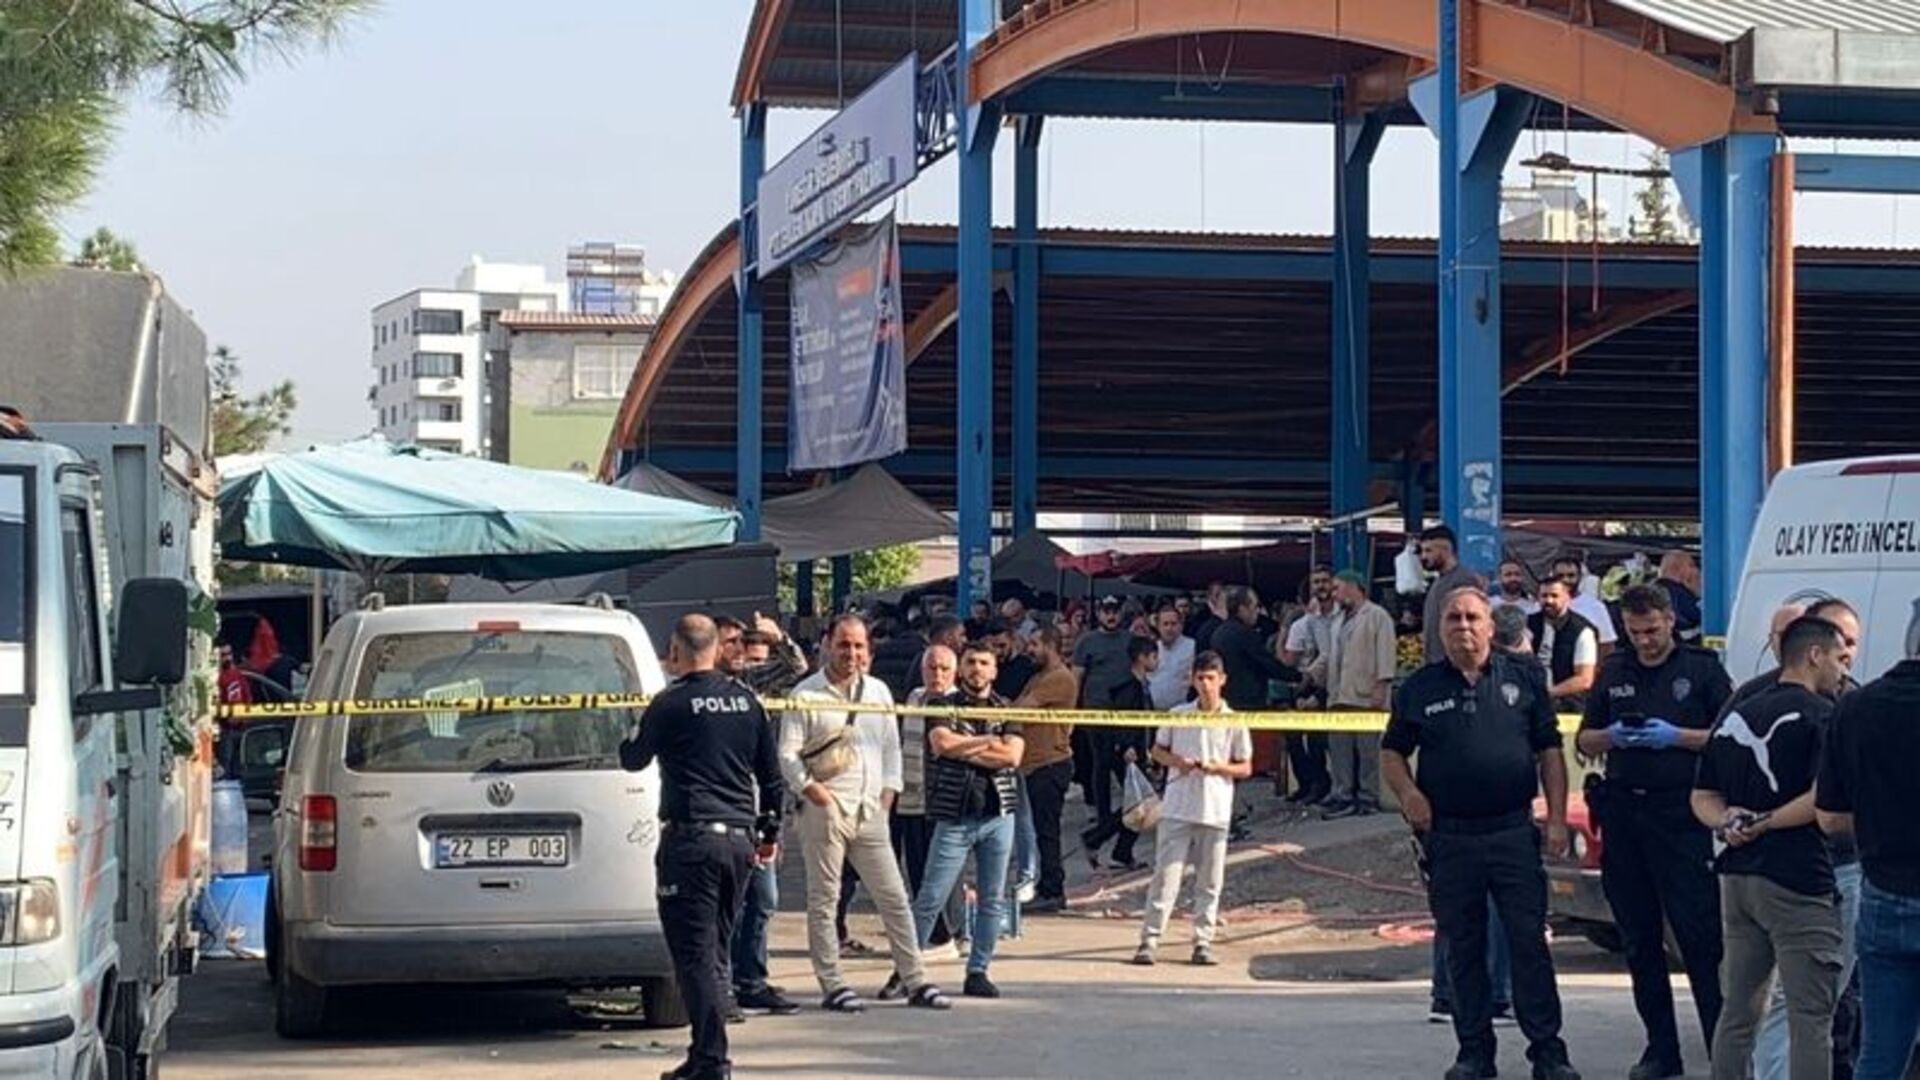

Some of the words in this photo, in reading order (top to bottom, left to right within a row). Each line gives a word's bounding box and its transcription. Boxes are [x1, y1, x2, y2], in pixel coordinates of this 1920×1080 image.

[1775, 524, 1819, 557] OLAY
[1820, 521, 1861, 555] YERİ
[1862, 520, 1920, 554] İNCEL
[451, 838, 472, 858] 22
[487, 838, 509, 858] EP
[529, 838, 563, 858] 003
